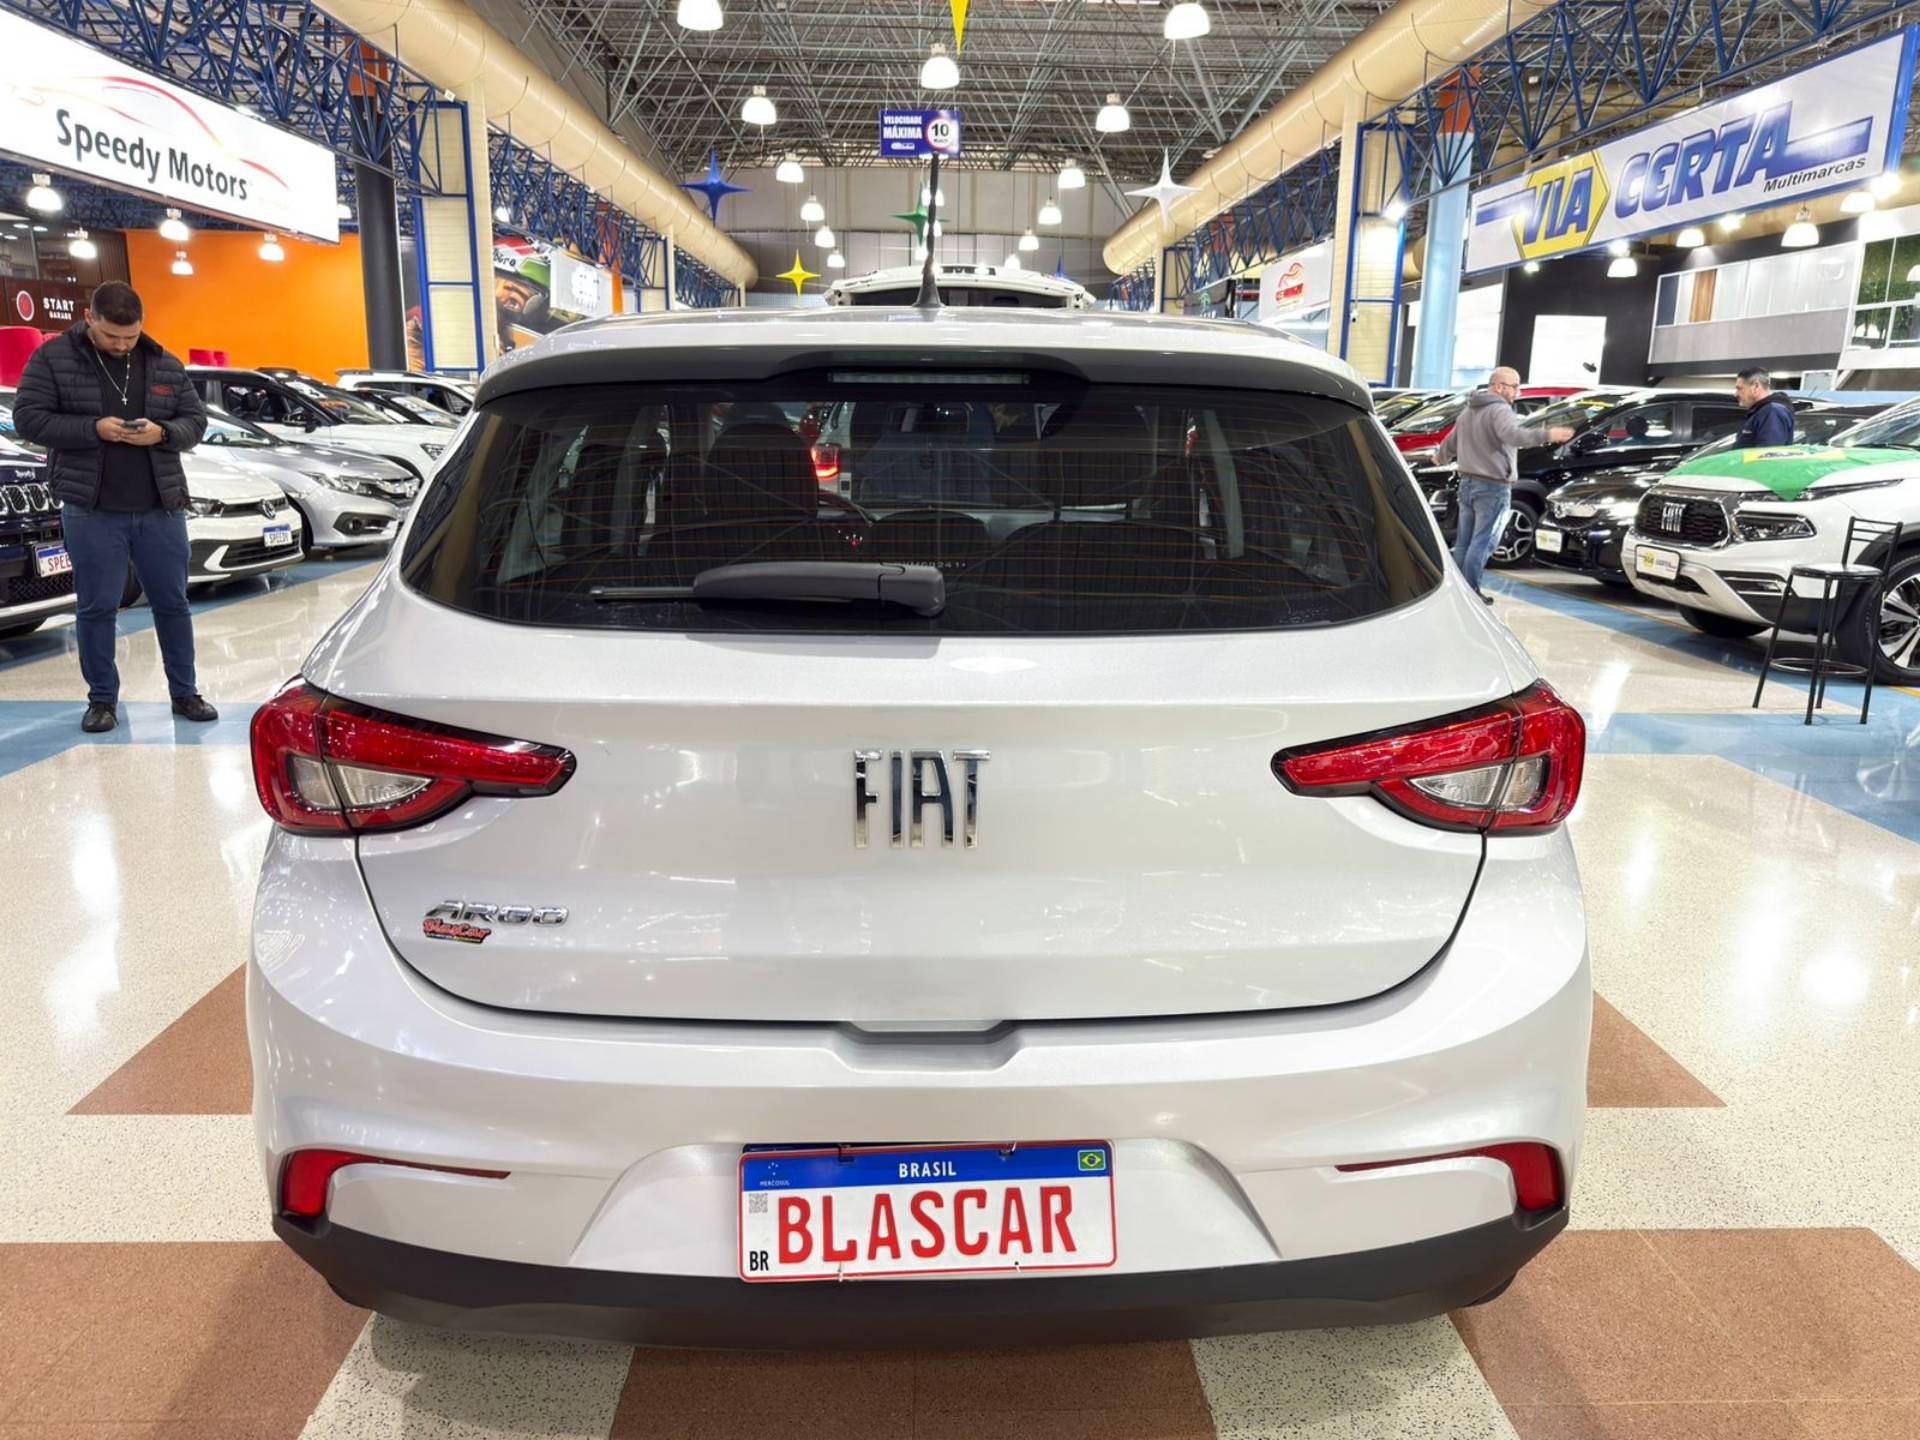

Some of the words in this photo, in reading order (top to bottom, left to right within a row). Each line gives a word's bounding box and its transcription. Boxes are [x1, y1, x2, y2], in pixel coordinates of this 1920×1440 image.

[883, 116, 922, 125] VELOCIDADE
[931, 123, 949, 137] 10
[883, 125, 923, 139] MÁXIMA
[56, 109, 160, 184] Speedy
[168, 148, 248, 200] Motors
[1512, 166, 1594, 245] VIA
[1614, 100, 1794, 218] CERTA
[1763, 156, 1866, 193] Multimarcas
[43, 297, 74, 312] START
[48, 554, 72, 572] SPEE
[855, 749, 991, 849] FIAT
[424, 900, 569, 926] ARGO
[899, 1160, 957, 1178] BRASIL
[778, 1186, 1077, 1265] BLASCAR
[749, 1250, 769, 1272] BR
